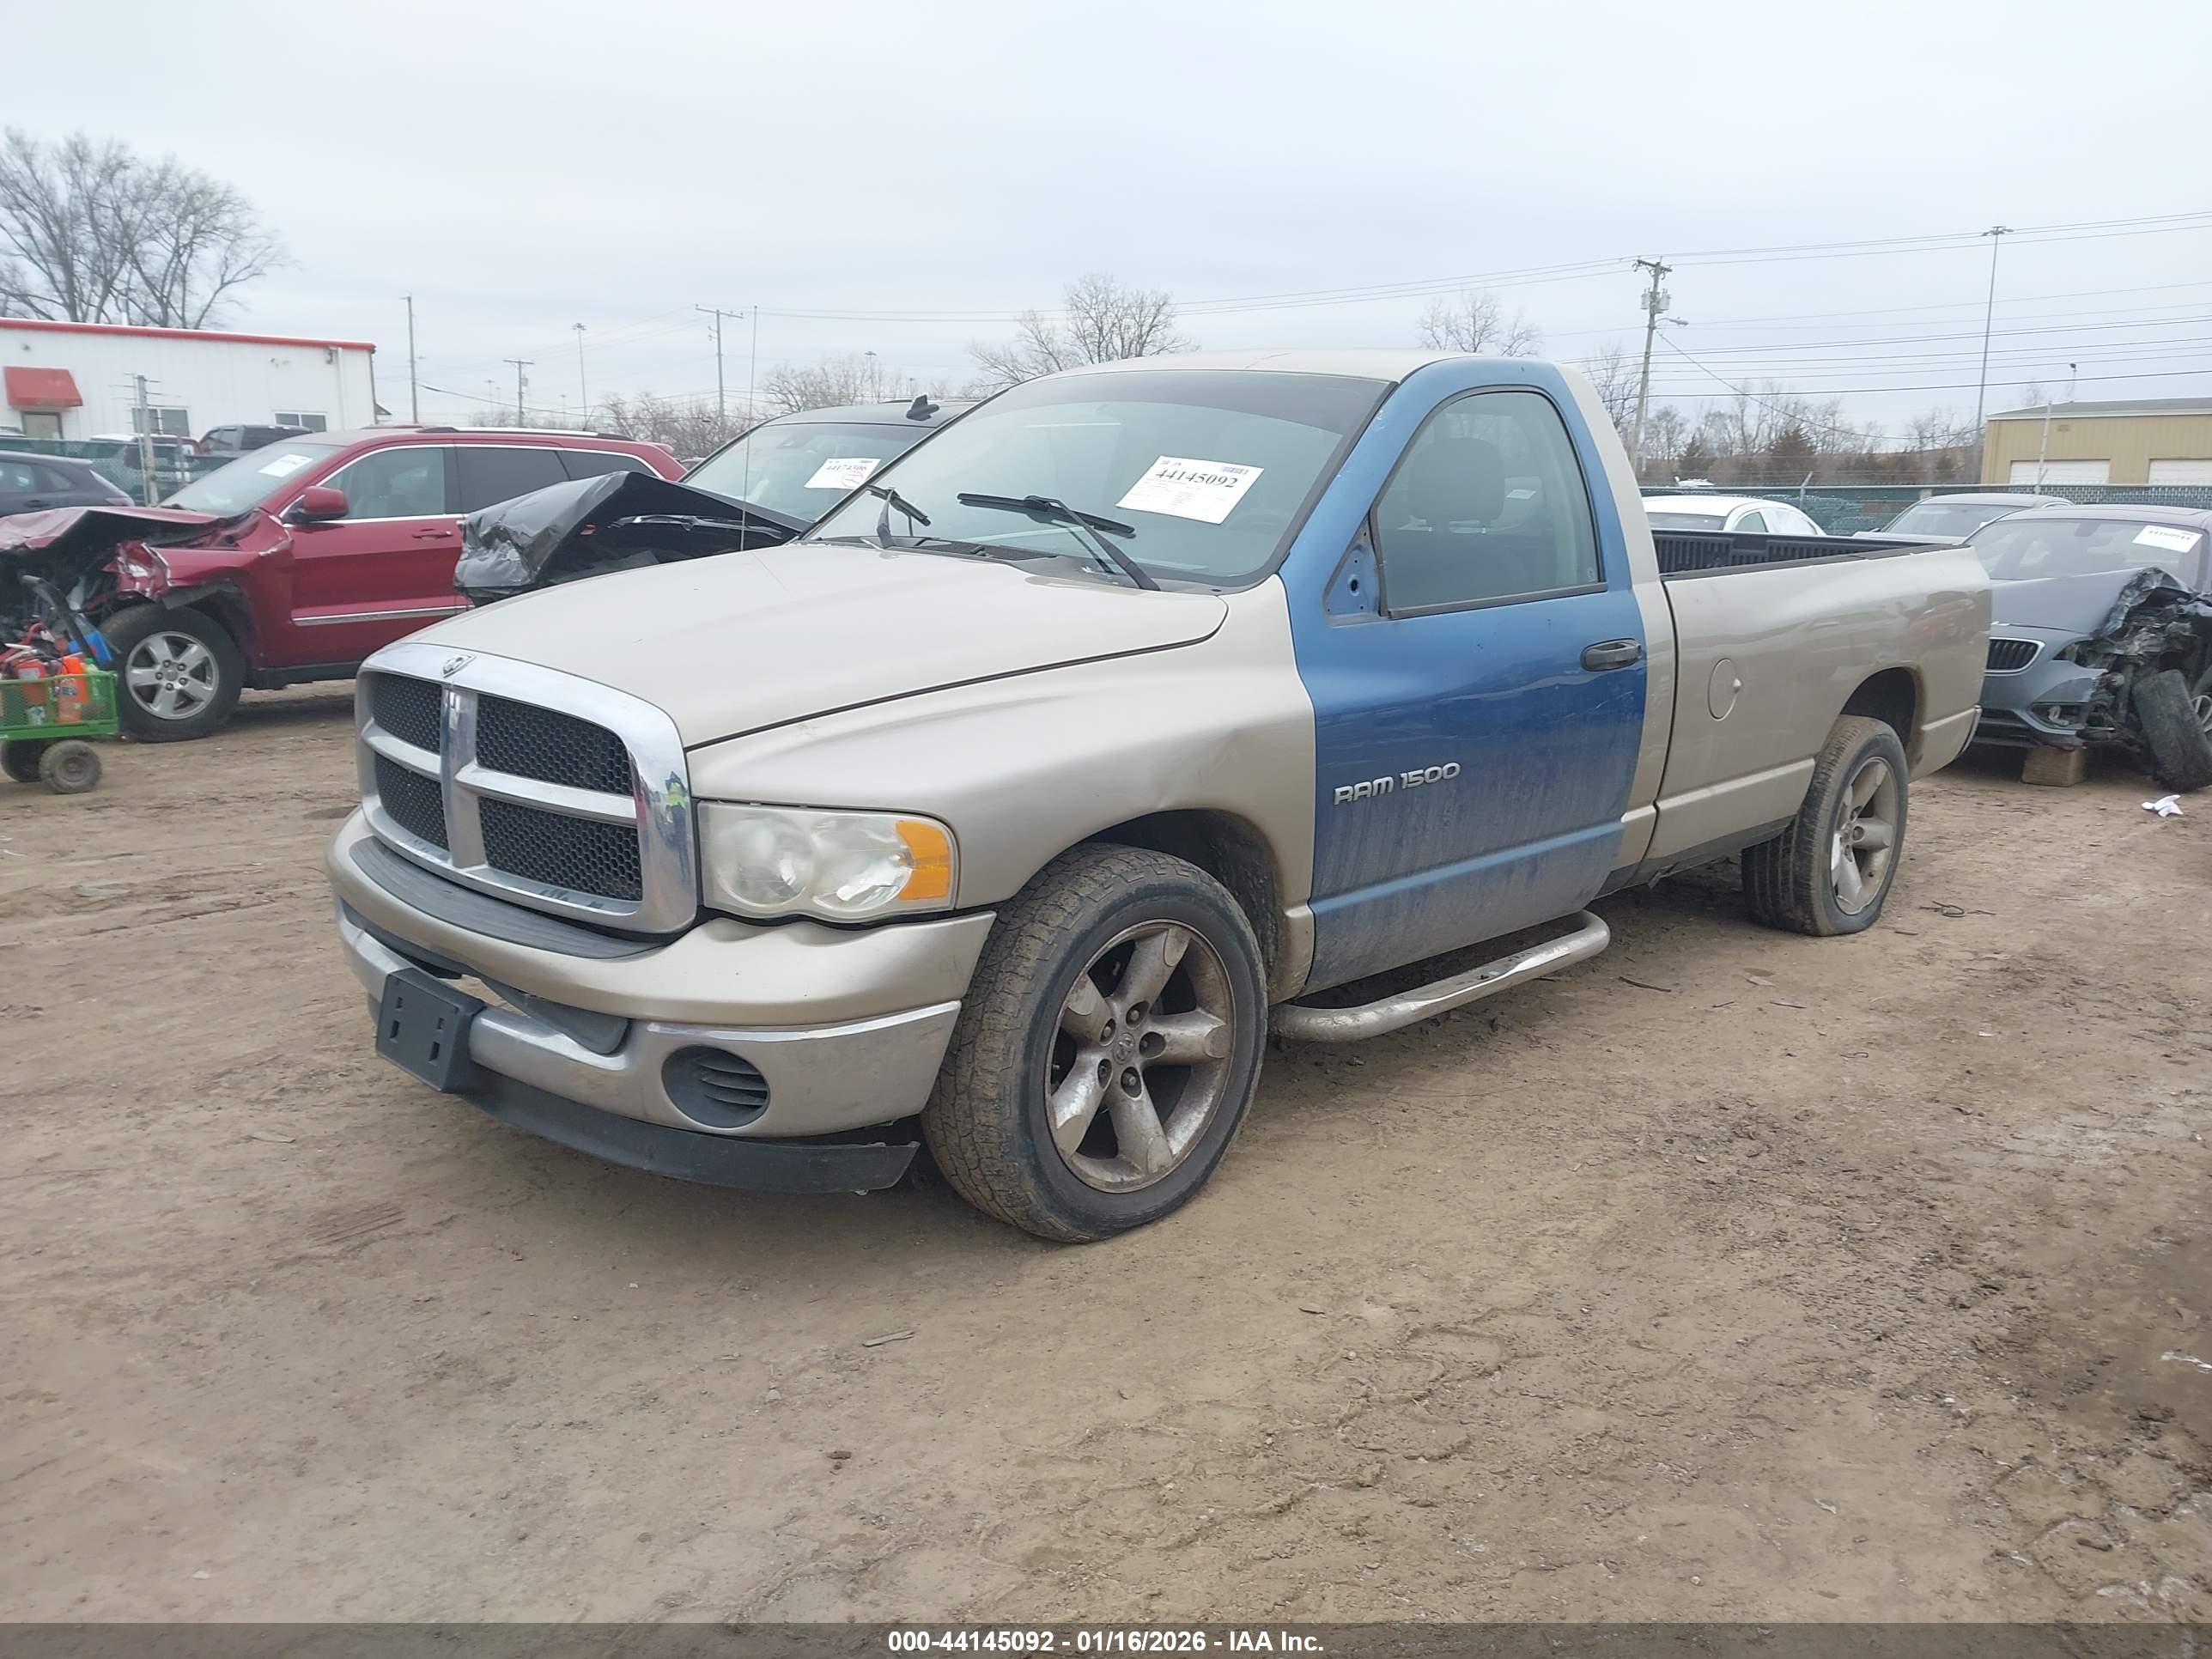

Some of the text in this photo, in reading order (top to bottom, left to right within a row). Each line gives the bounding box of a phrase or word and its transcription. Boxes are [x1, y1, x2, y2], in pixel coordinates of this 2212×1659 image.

[1155, 469, 1239, 489] 44145092
[1333, 762, 1462, 805] RAM 1500
